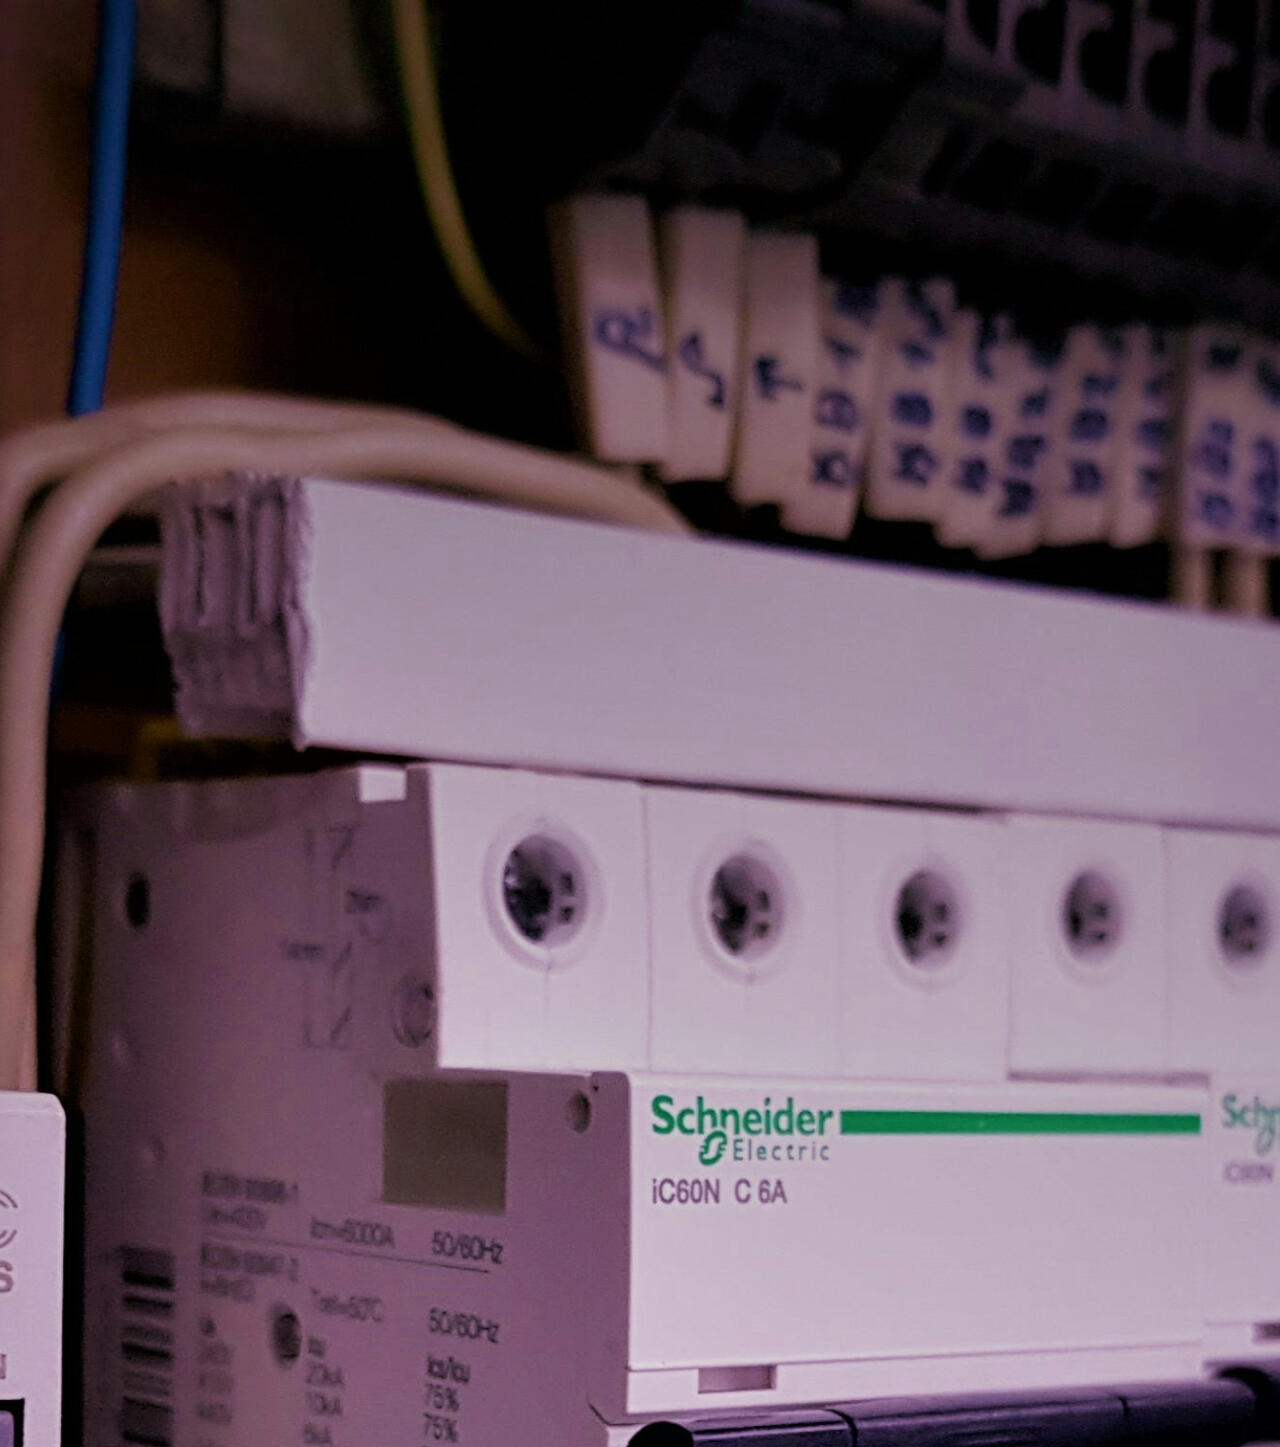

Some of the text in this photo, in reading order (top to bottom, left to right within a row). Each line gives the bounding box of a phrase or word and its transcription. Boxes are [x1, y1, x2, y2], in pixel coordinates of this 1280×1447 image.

[651, 1094, 833, 1135] Schneider
[732, 1138, 830, 1161] Electric
[652, 1178, 788, 1204] iC60N C 6A
